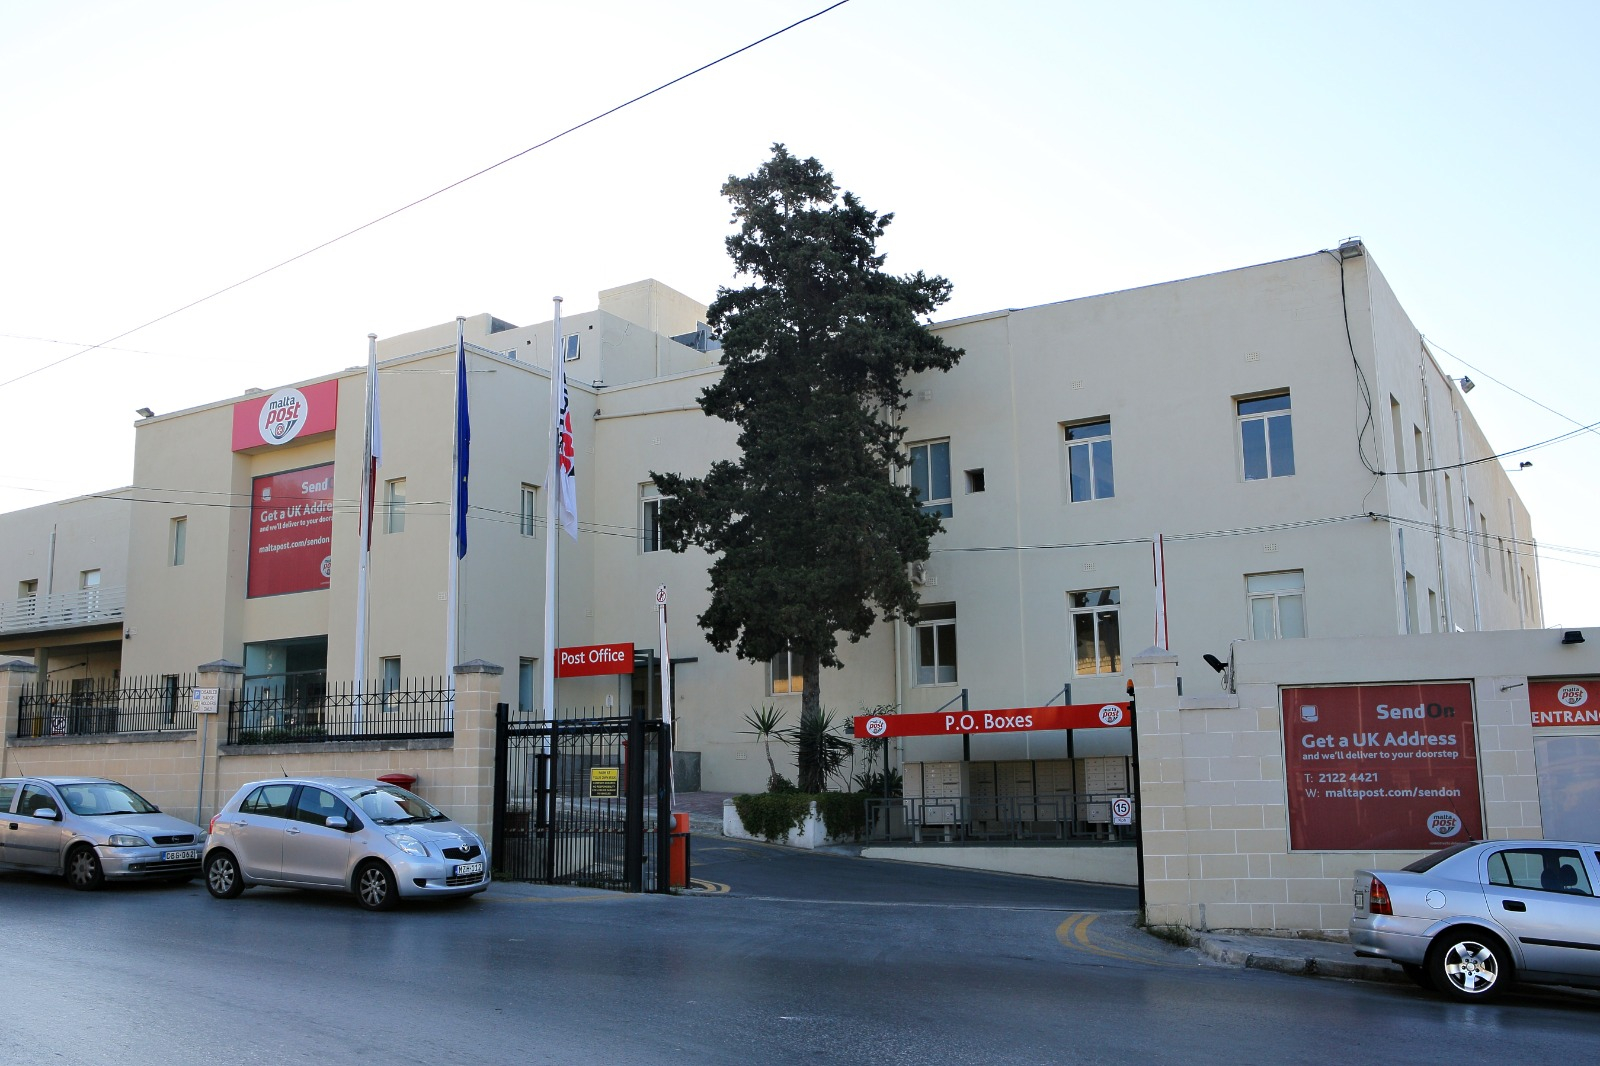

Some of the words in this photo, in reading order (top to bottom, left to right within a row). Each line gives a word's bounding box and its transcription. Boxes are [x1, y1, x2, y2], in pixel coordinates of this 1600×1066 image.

[270, 397, 295, 410] malta
[265, 402, 300, 429] post
[260, 510, 278, 523] Get
[287, 504, 302, 517] UK
[259, 524, 269, 533] and
[282, 519, 299, 529] deliver
[306, 518, 319, 527] your
[259, 536, 330, 553] maltapost.com/sendon
[561, 652, 586, 665] Post
[589, 648, 625, 663] Office
[1562, 690, 1584, 700] post
[1102, 710, 1119, 718] post
[1376, 703, 1455, 719] SendOn
[1531, 710, 1600, 723] ENTRAN
[869, 722, 884, 730] post
[945, 714, 979, 731] P.O.
[984, 713, 1033, 729] Boxes
[1301, 734, 1335, 748] Get
[1338, 737, 1349, 747] a
[1352, 732, 1380, 747] UK
[1384, 731, 1457, 747] Address
[1302, 752, 1320, 760] and
[1321, 751, 1344, 760] we'll
[1345, 750, 1378, 760] deliver
[1379, 751, 1390, 759] to
[1391, 751, 1414, 761] your
[1415, 750, 1459, 760] doorstep
[1304, 773, 1314, 783] T:
[1318, 773, 1347, 783] 2122
[1349, 772, 1379, 783] 4421
[1305, 788, 1320, 798] W:
[1325, 786, 1461, 800] maltapost.com/sendon
[1116, 803, 1127, 813] 15
[1431, 818, 1457, 828] post
